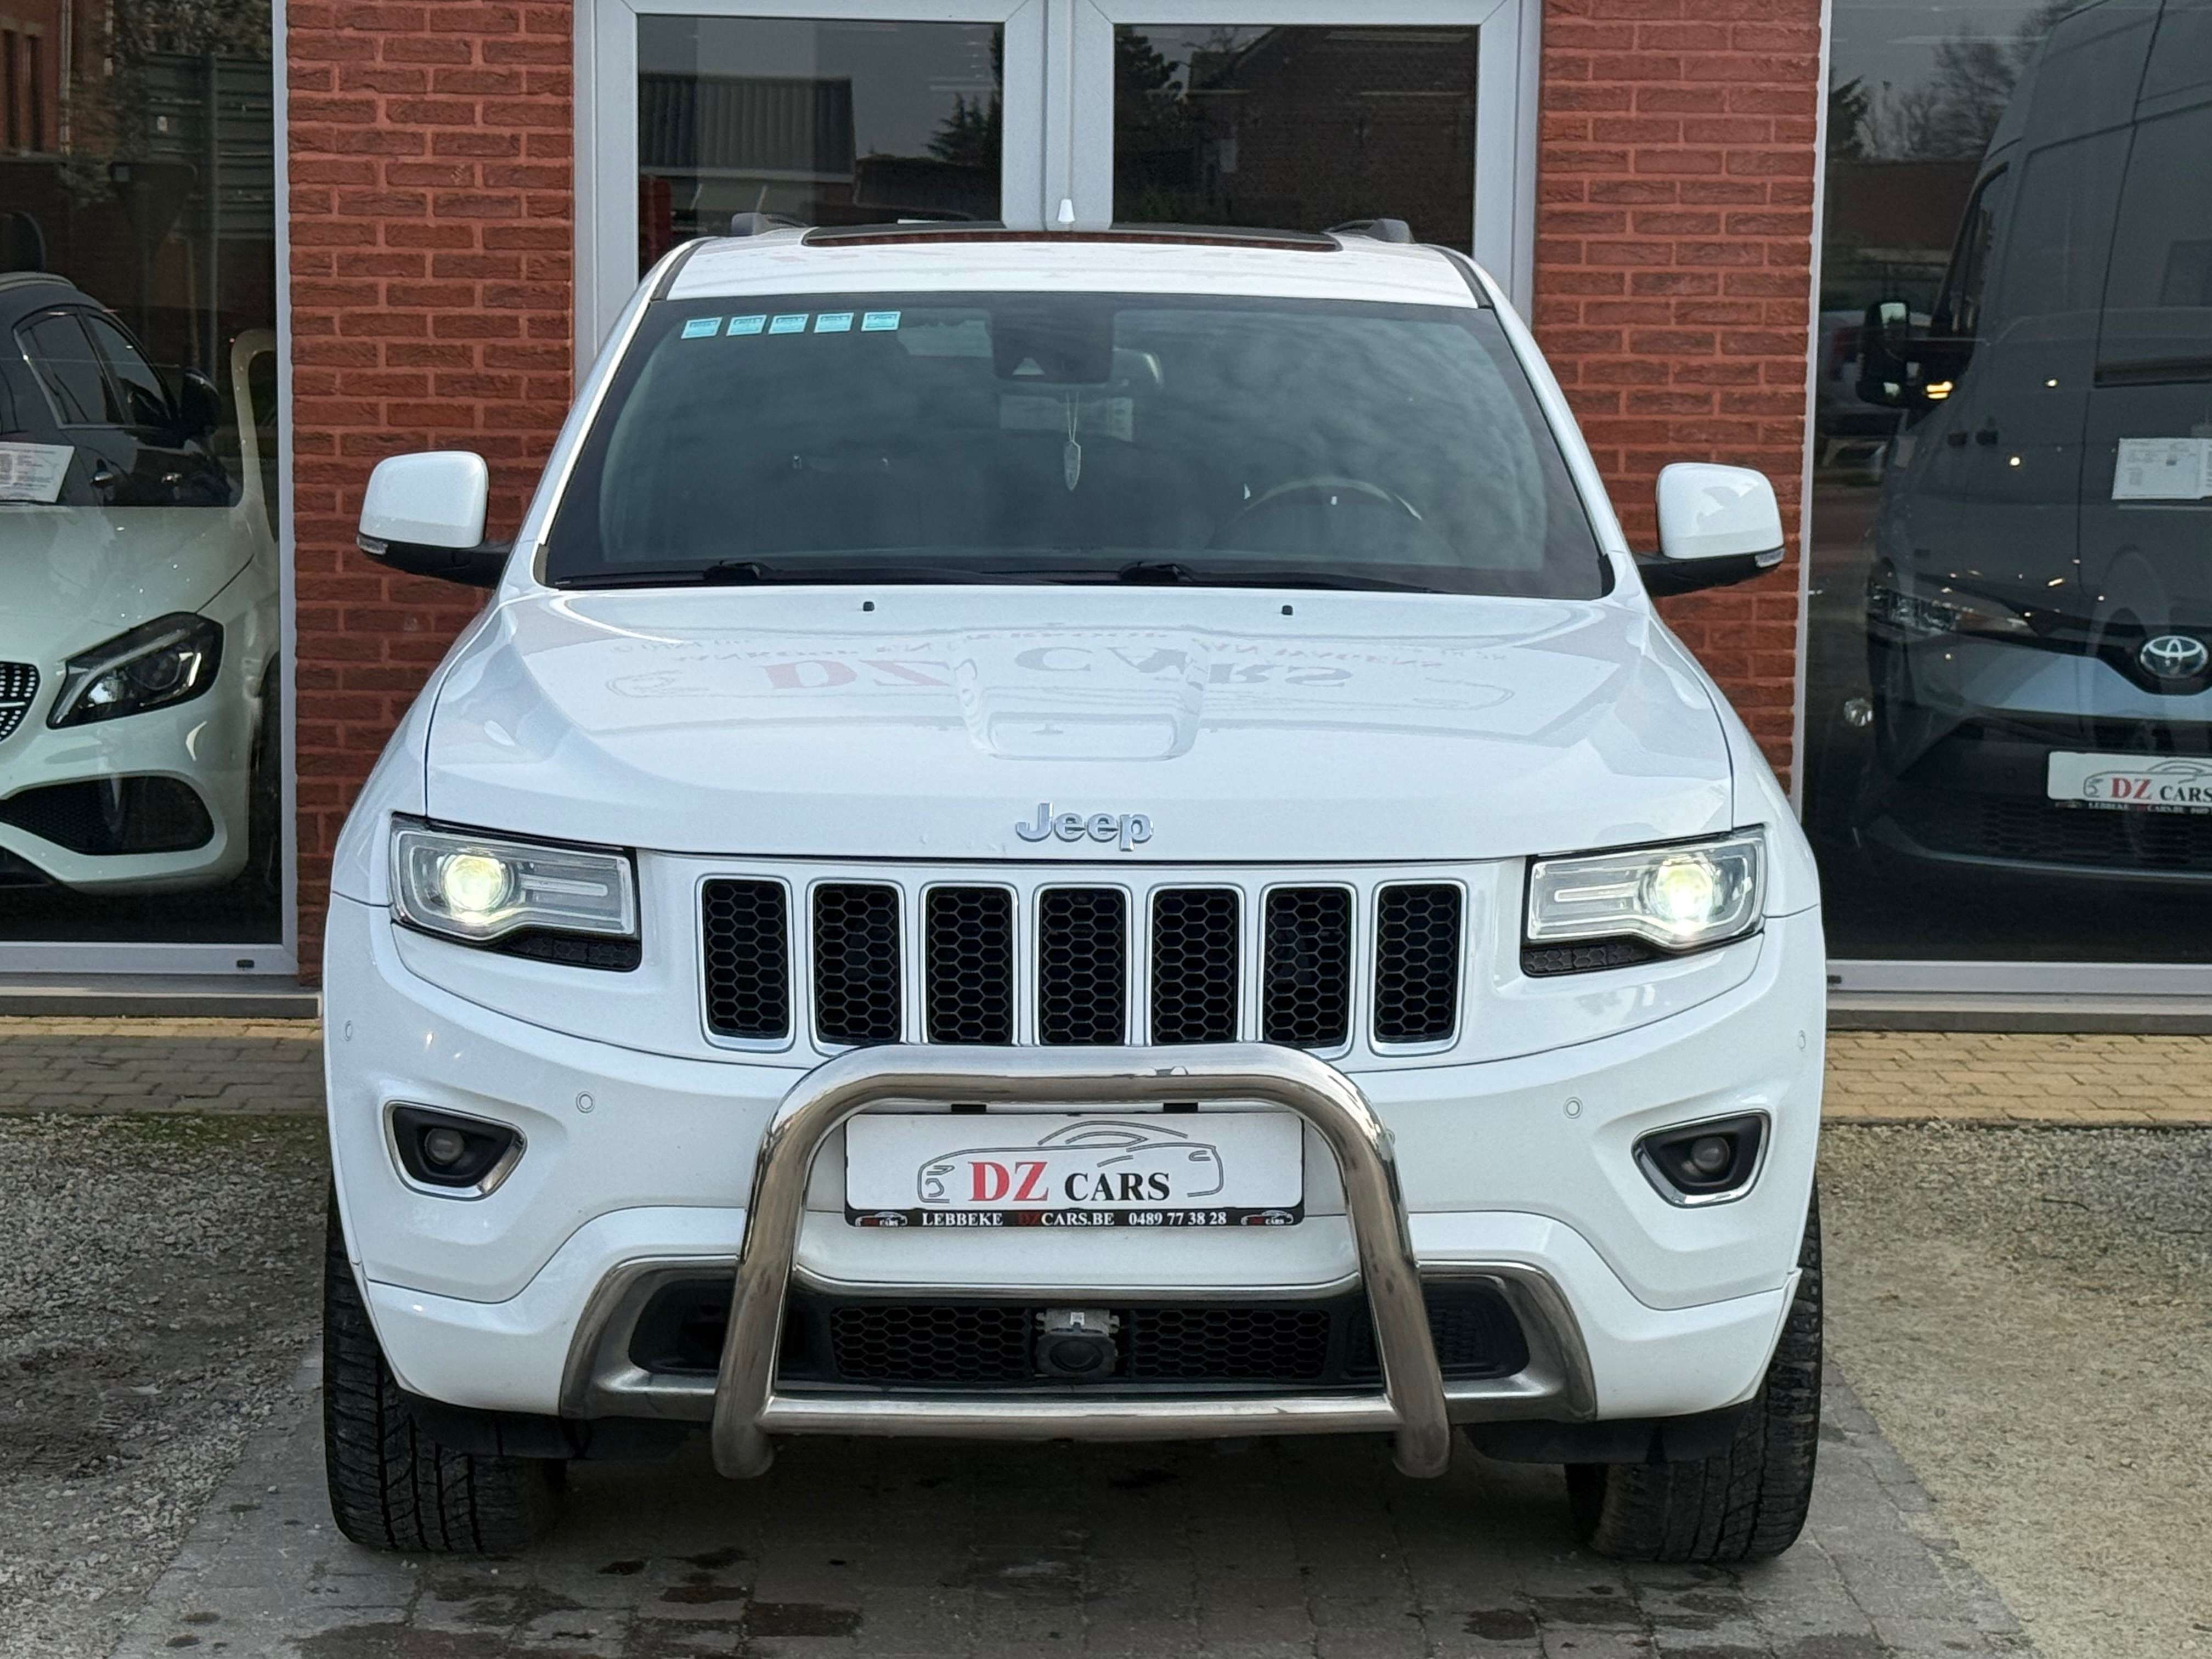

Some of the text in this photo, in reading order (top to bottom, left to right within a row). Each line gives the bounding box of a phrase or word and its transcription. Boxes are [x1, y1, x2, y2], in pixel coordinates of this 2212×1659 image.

[2111, 777, 2212, 803] DZ CARS
[1015, 802, 1154, 852] Jeep
[968, 1161, 1171, 1202] DZ CARS
[922, 1212, 1003, 1226] LEBBEKE
[1128, 1212, 1163, 1226] 0489
[1166, 1212, 1184, 1226] 77
[1188, 1212, 1206, 1225] 38
[1209, 1211, 1227, 1225] 28
